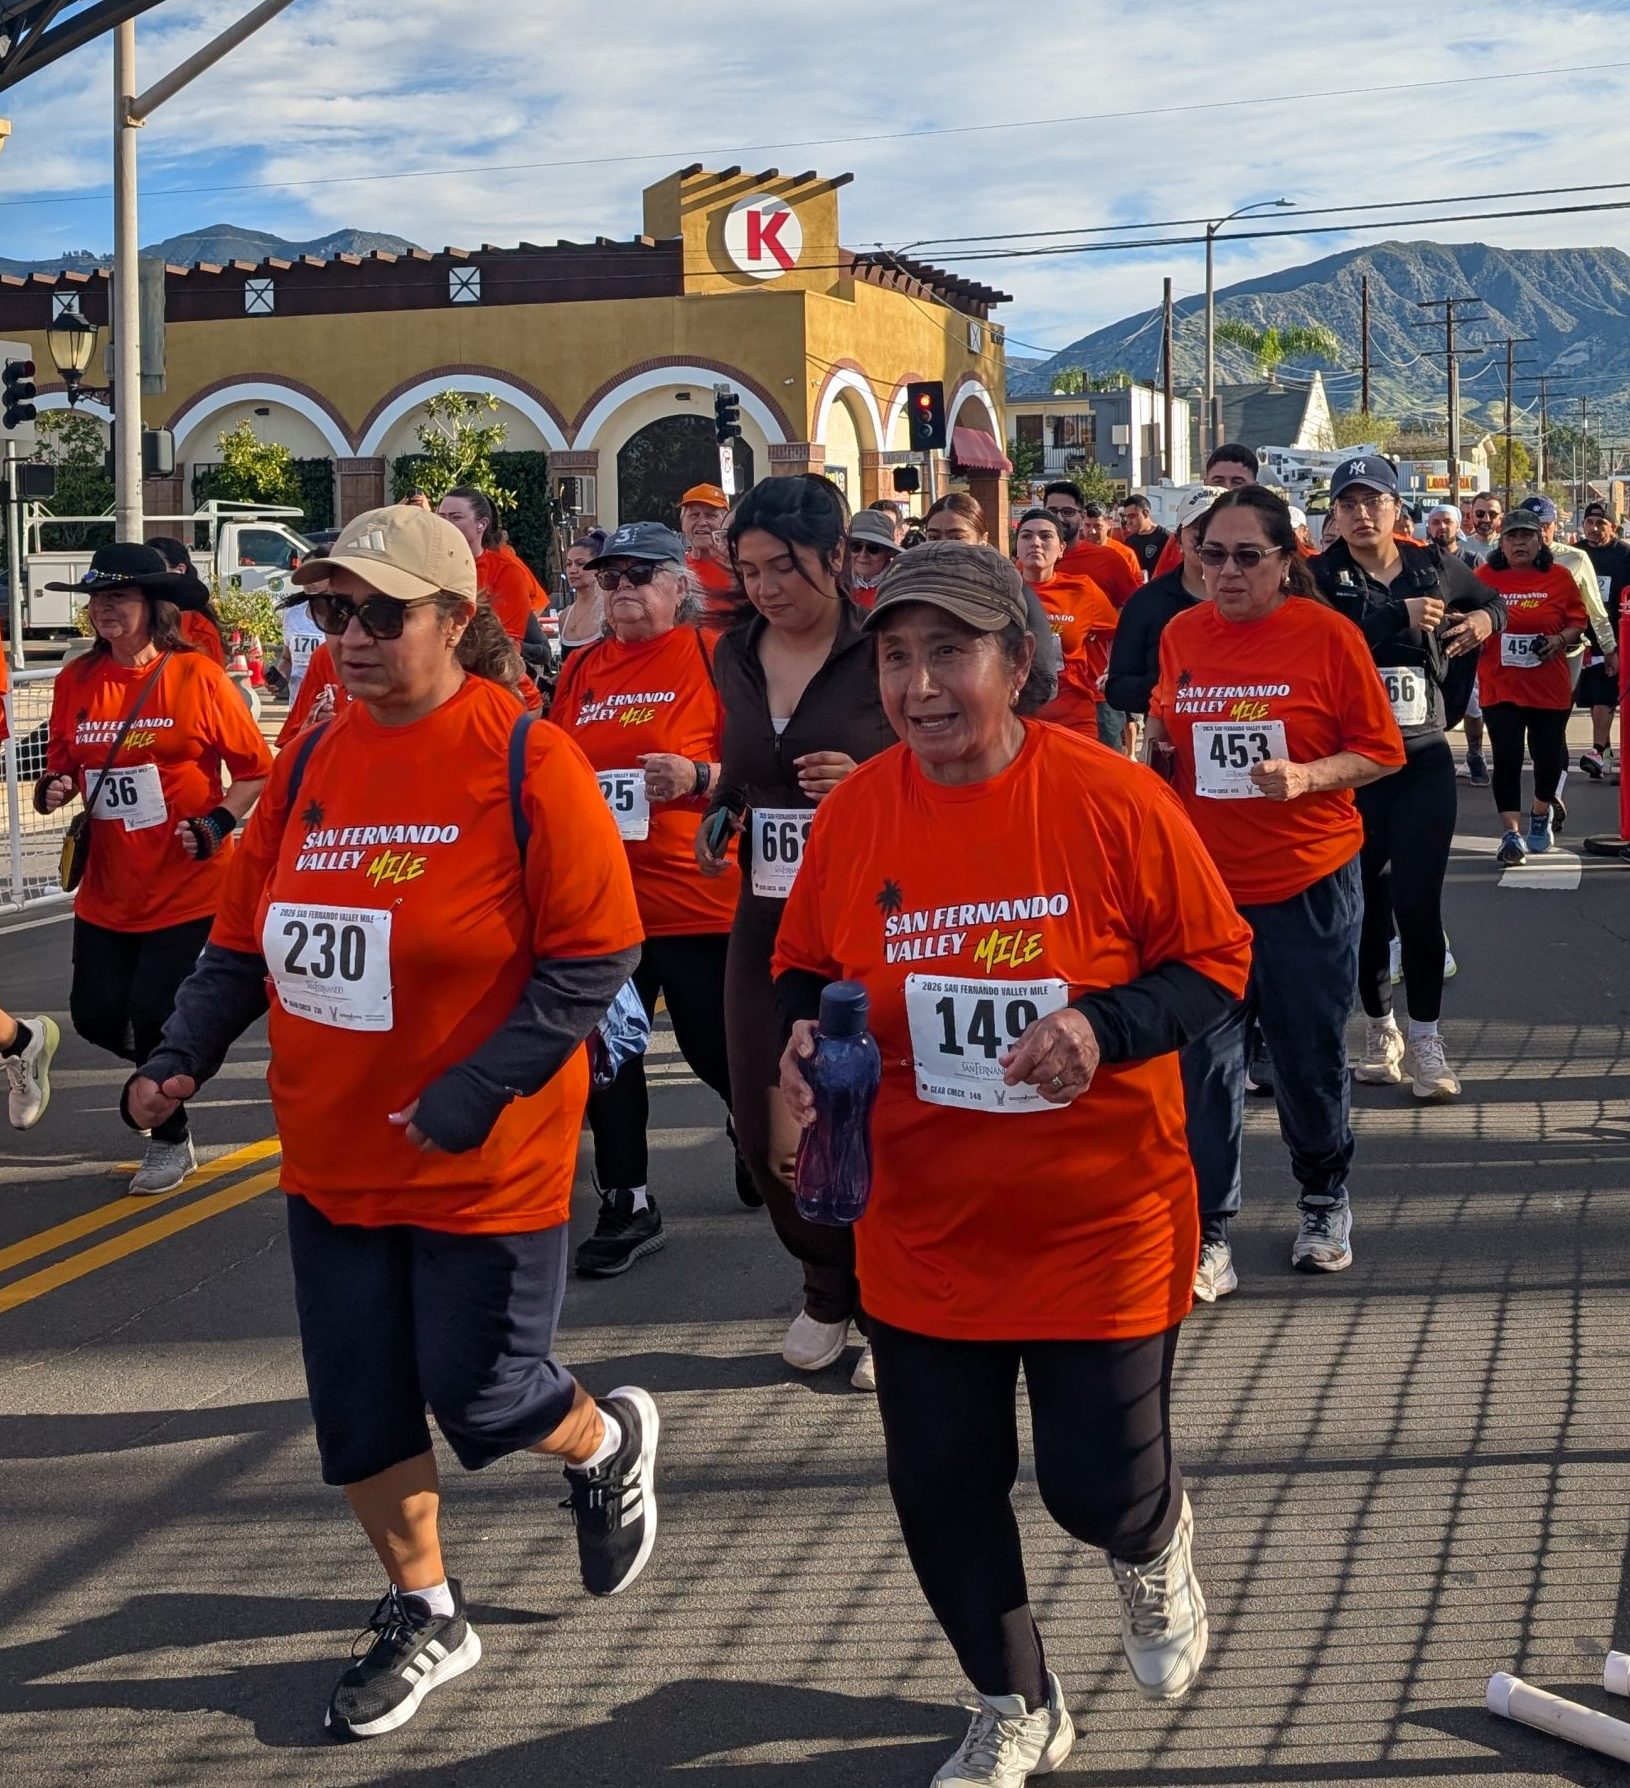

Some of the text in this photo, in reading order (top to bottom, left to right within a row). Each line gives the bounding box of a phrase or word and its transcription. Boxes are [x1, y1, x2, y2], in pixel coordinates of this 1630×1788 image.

[747, 210, 795, 271] K
[1349, 461, 1366, 475] NY
[606, 691, 675, 706] ERNANDO
[1177, 684, 1290, 699] SAN FERNANDO
[619, 707, 655, 728] MILE
[1175, 700, 1269, 722] VALLEY MILE
[76, 721, 101, 732] SAN
[123, 730, 156, 751] MILE
[1210, 733, 1271, 768] 453
[104, 776, 138, 808] 36
[302, 825, 459, 850] SAN FERNANDO
[295, 850, 427, 888] VALLEY MILE
[280, 908, 375, 924] 2026 SAN FERNANDO VALLEY MILE
[884, 893, 1069, 937] SAN FERNANDO
[282, 920, 366, 982] 230
[885, 928, 1044, 975] VALLEY MILE
[922, 982, 1049, 996] 2026 SAN FERNANDO VALLEY MILE
[935, 996, 1039, 1059] 149
[975, 1062, 1005, 1076] FERNAN
[930, 1085, 982, 1101] GEAR CHECK 149
